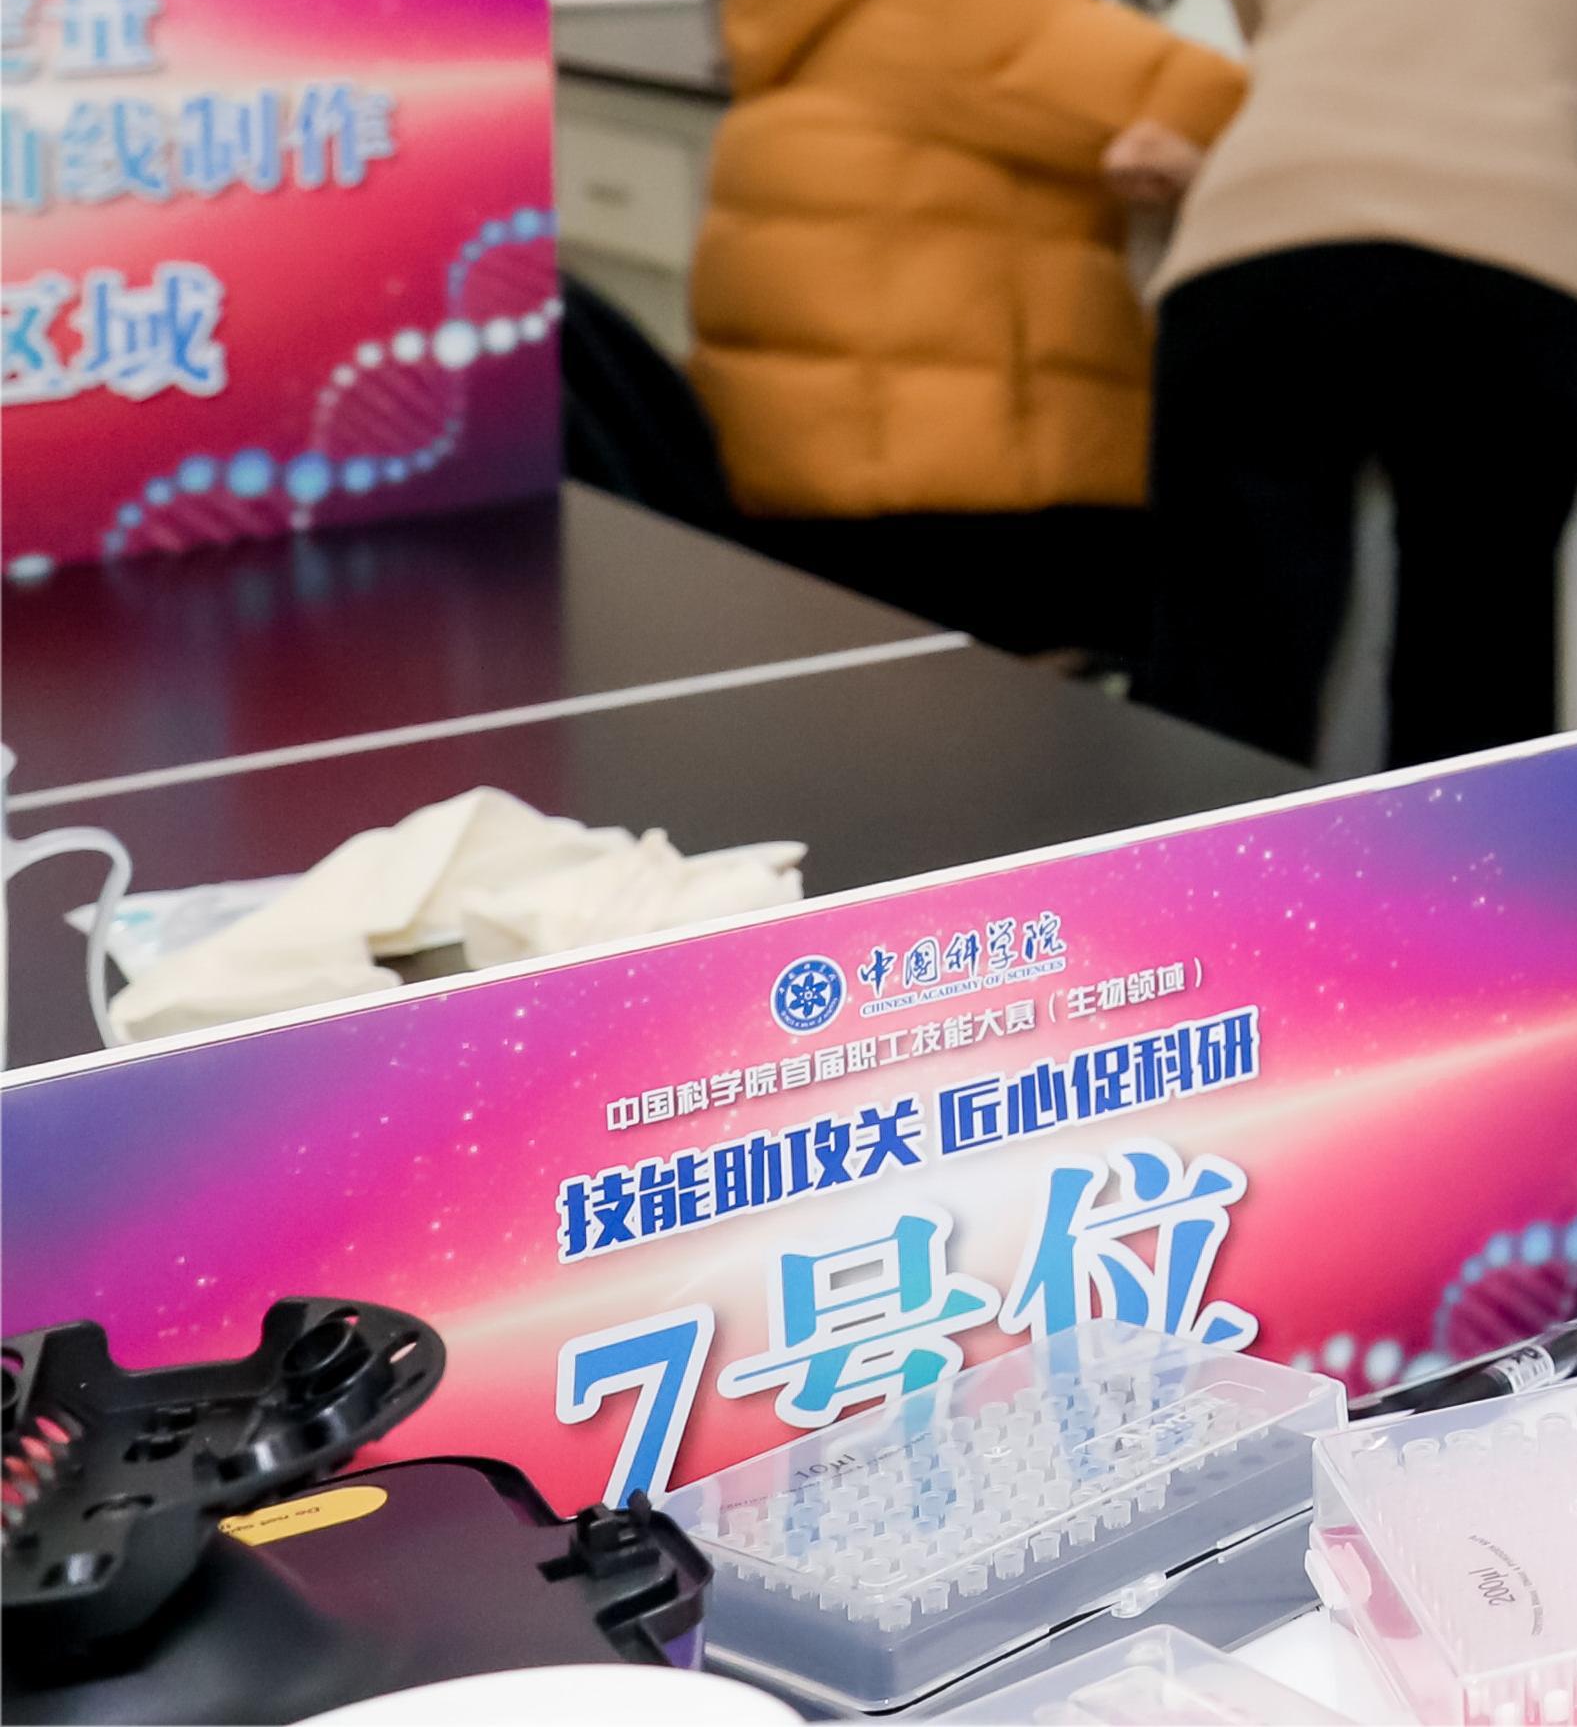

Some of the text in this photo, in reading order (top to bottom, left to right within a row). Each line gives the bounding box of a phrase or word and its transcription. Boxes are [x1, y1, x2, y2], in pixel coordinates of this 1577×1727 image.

[861, 958, 1064, 1016] CHINESE ACADEMY OF SCIENCES
[557, 1010, 1257, 1259] 技能助攻关 匠心促科研
[560, 1141, 1256, 1513] 7号位
